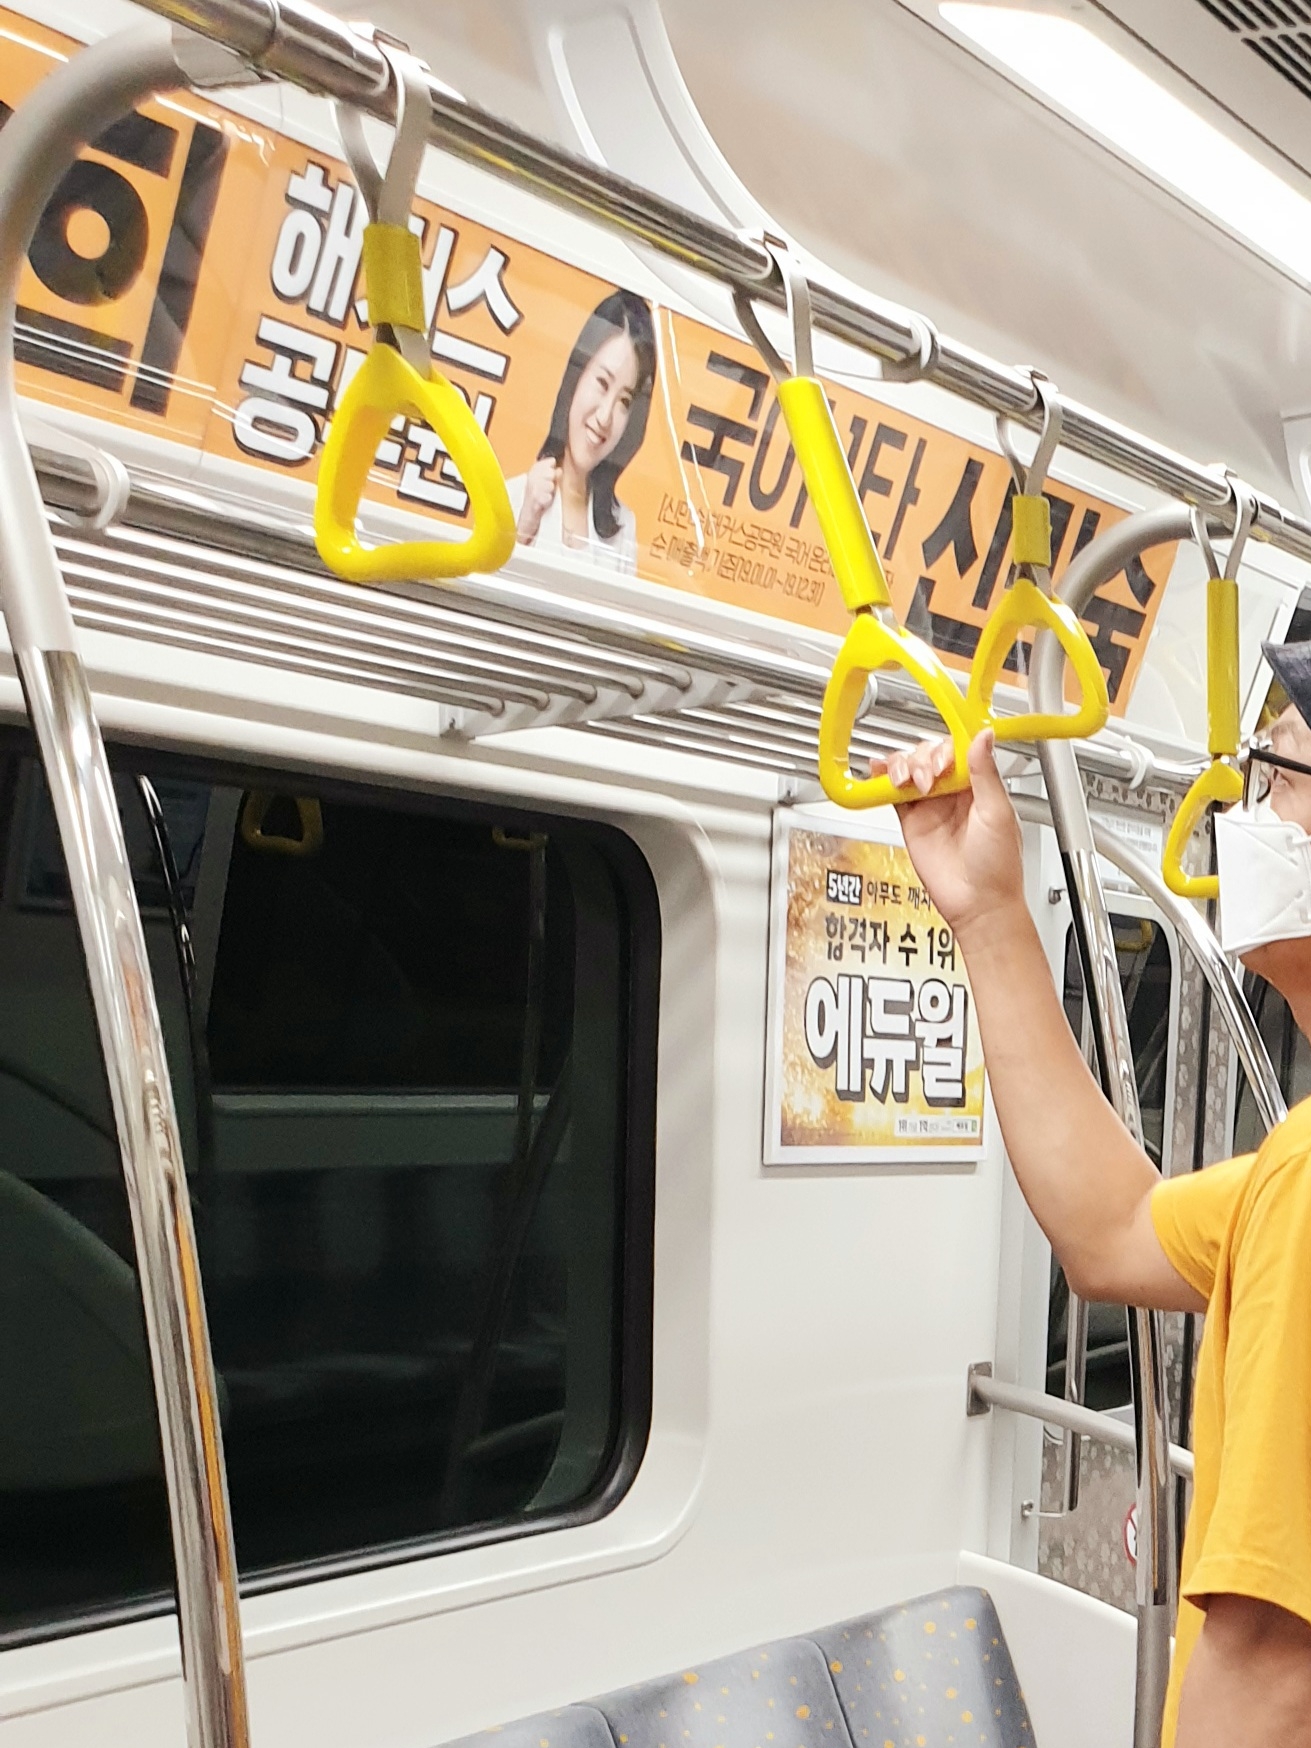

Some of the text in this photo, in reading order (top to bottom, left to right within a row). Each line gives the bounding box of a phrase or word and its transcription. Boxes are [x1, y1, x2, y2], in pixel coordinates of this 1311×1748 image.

[231, 312, 498, 518] 공원
[827, 871, 862, 905] 5년간
[866, 880, 902, 906] 아무도
[825, 911, 956, 972] 합격자 수 1위
[804, 973, 968, 1107] 에듀윌
